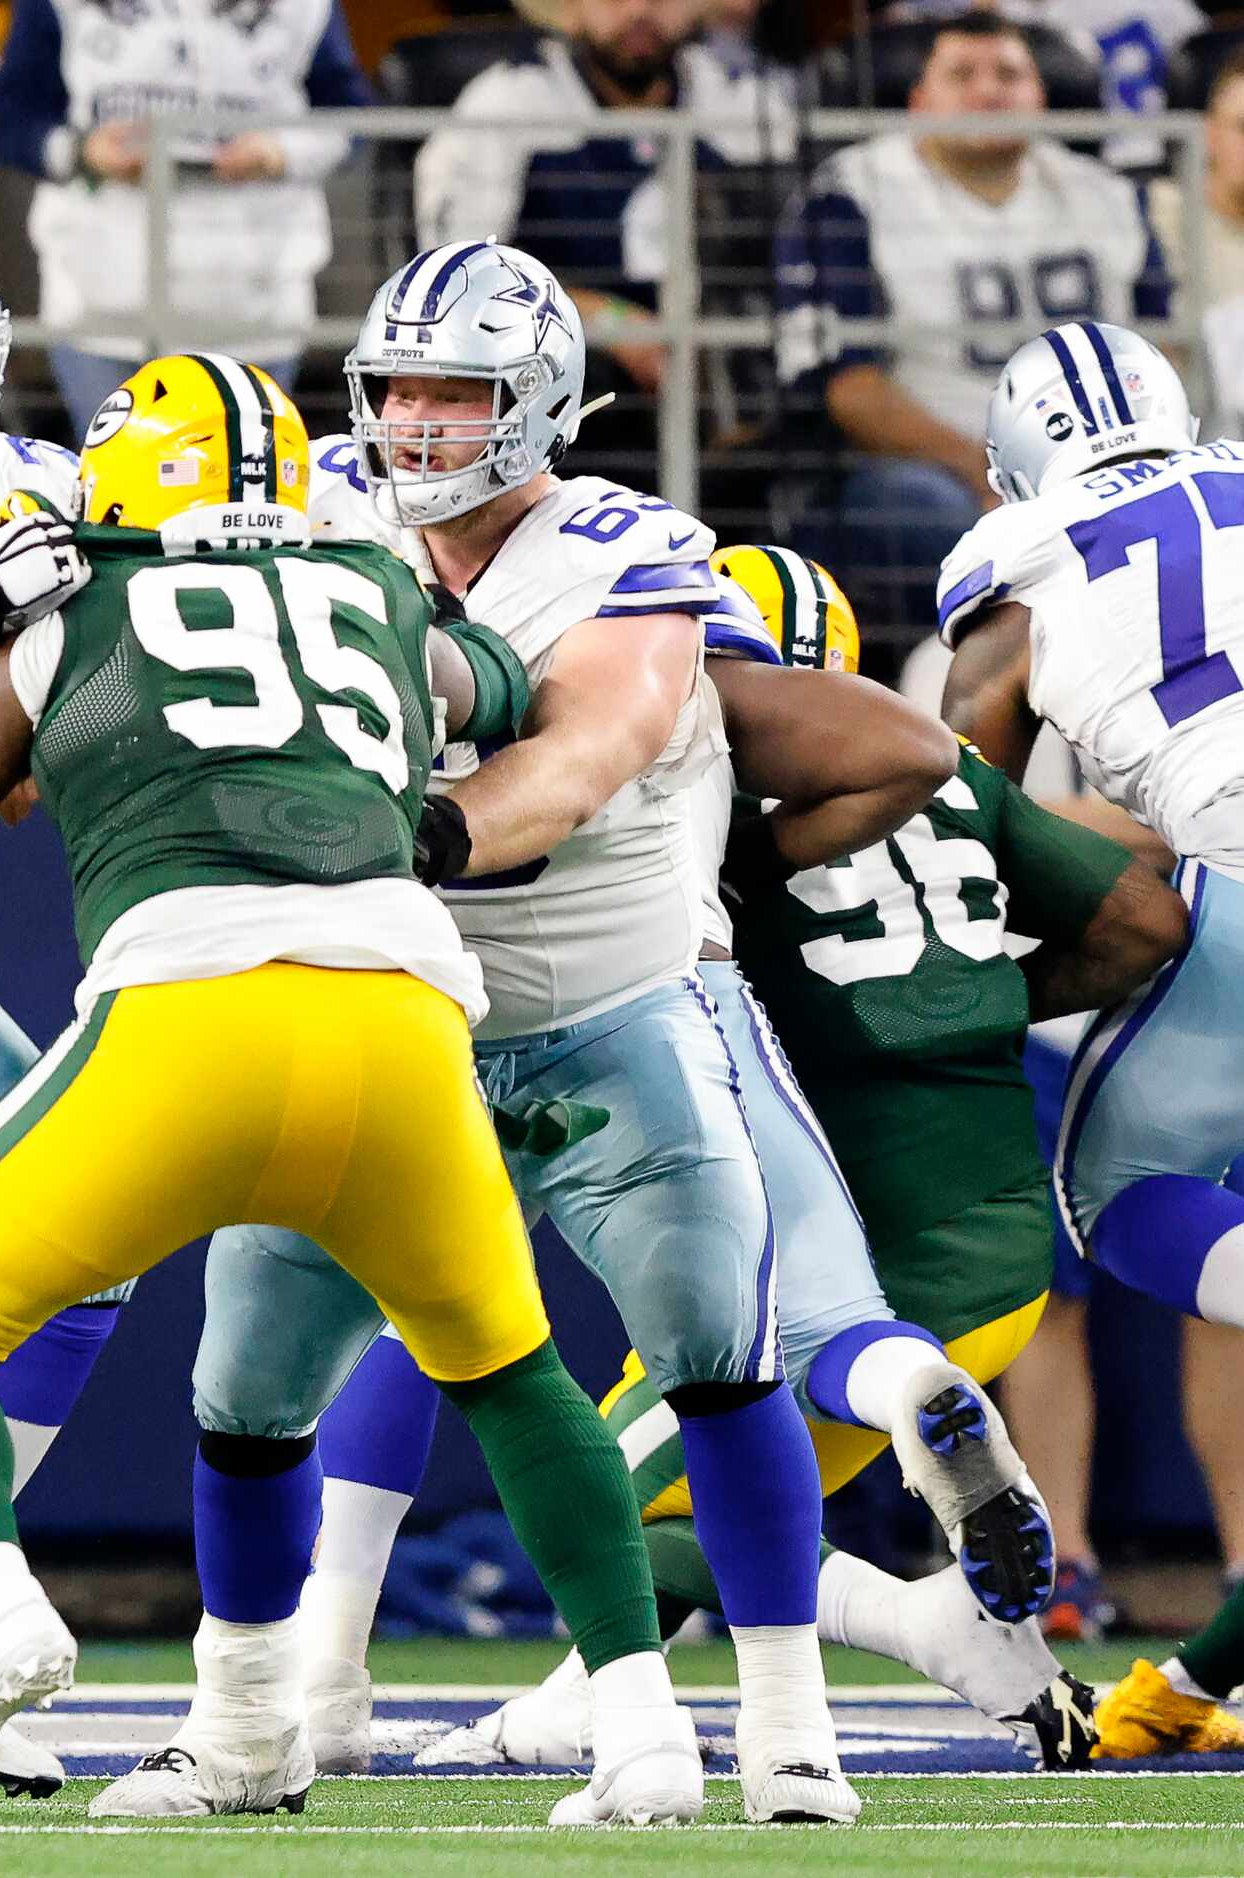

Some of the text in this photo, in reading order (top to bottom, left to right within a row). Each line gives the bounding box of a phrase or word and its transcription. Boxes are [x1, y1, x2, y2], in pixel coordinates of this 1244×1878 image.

[382, 348, 425, 358] COWBOYS
[1091, 431, 1138, 454] BE LOVE
[240, 461, 268, 476] MLK
[222, 514, 284, 529] BE LOVE
[126, 556, 410, 796] 95
